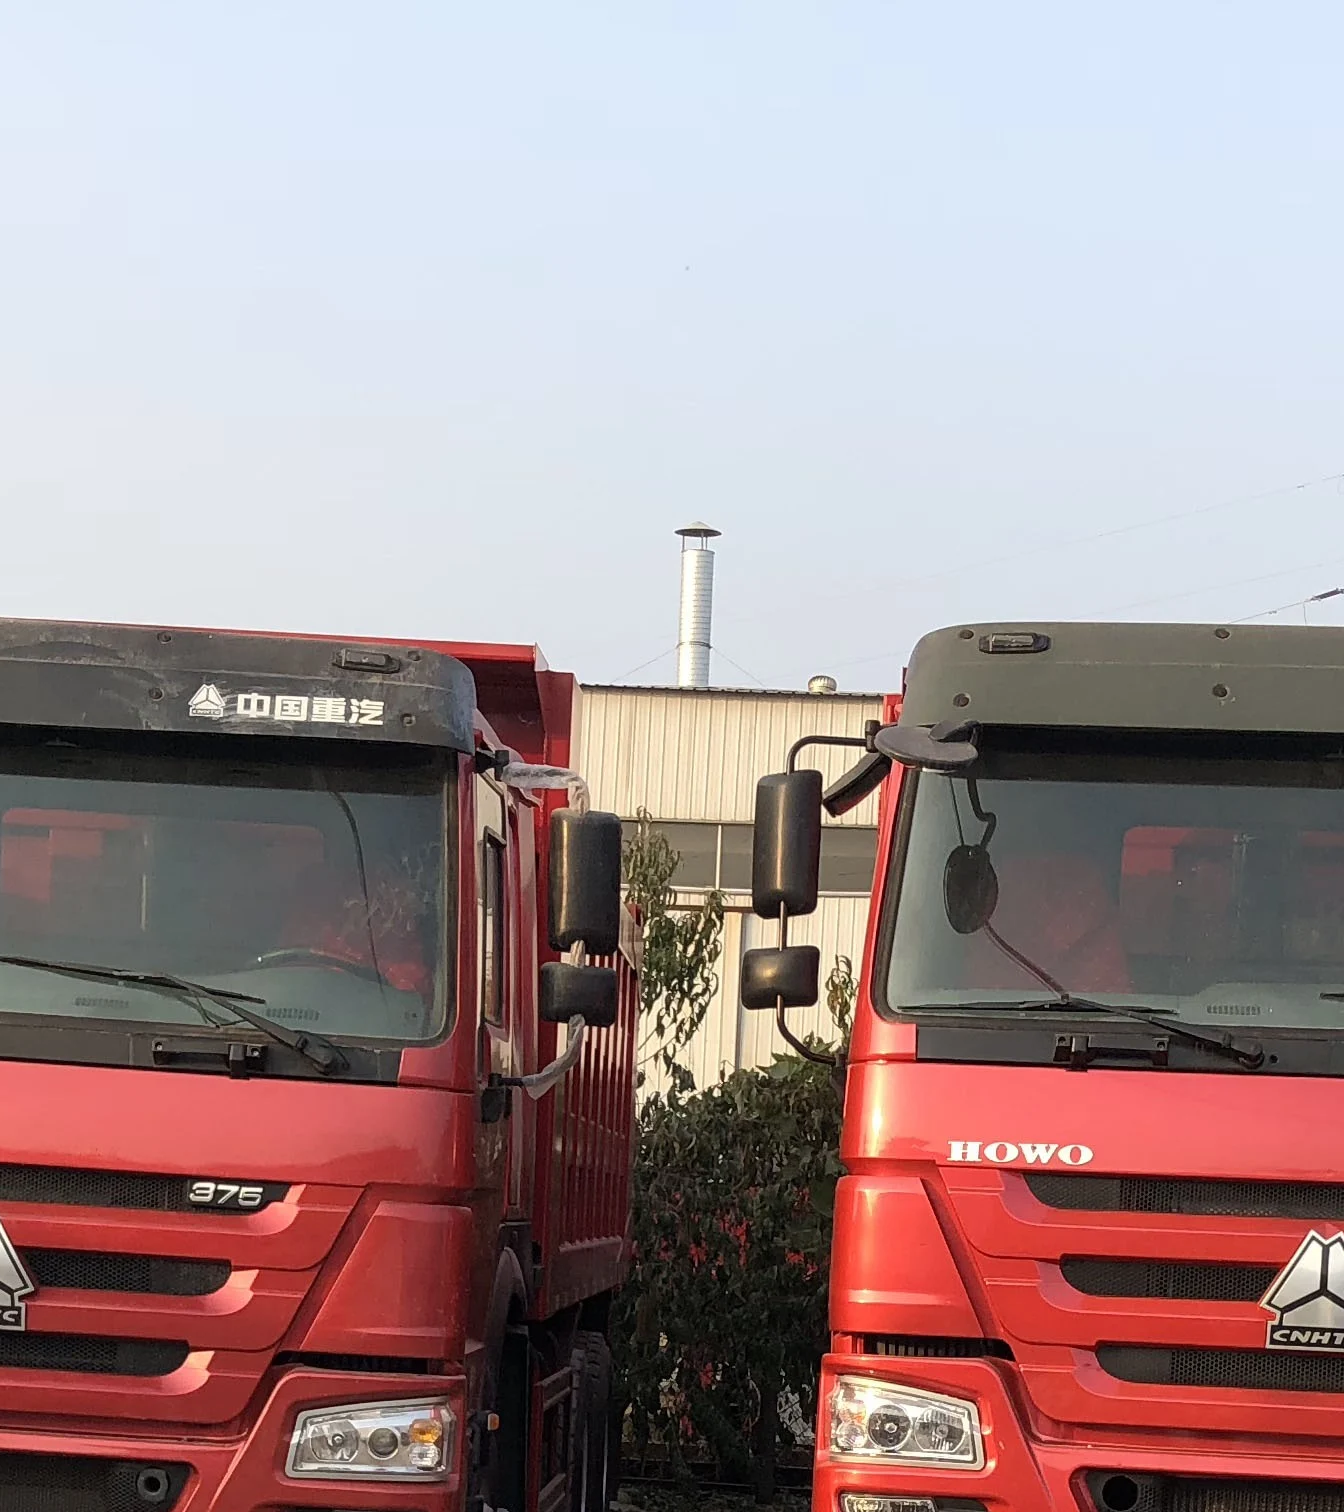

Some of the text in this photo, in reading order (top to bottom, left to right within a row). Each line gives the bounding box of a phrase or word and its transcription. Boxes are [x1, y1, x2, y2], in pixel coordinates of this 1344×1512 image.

[237, 692, 385, 725] 中国重汽
[946, 1140, 1094, 1166] HOWO
[189, 1181, 264, 1206] 375
